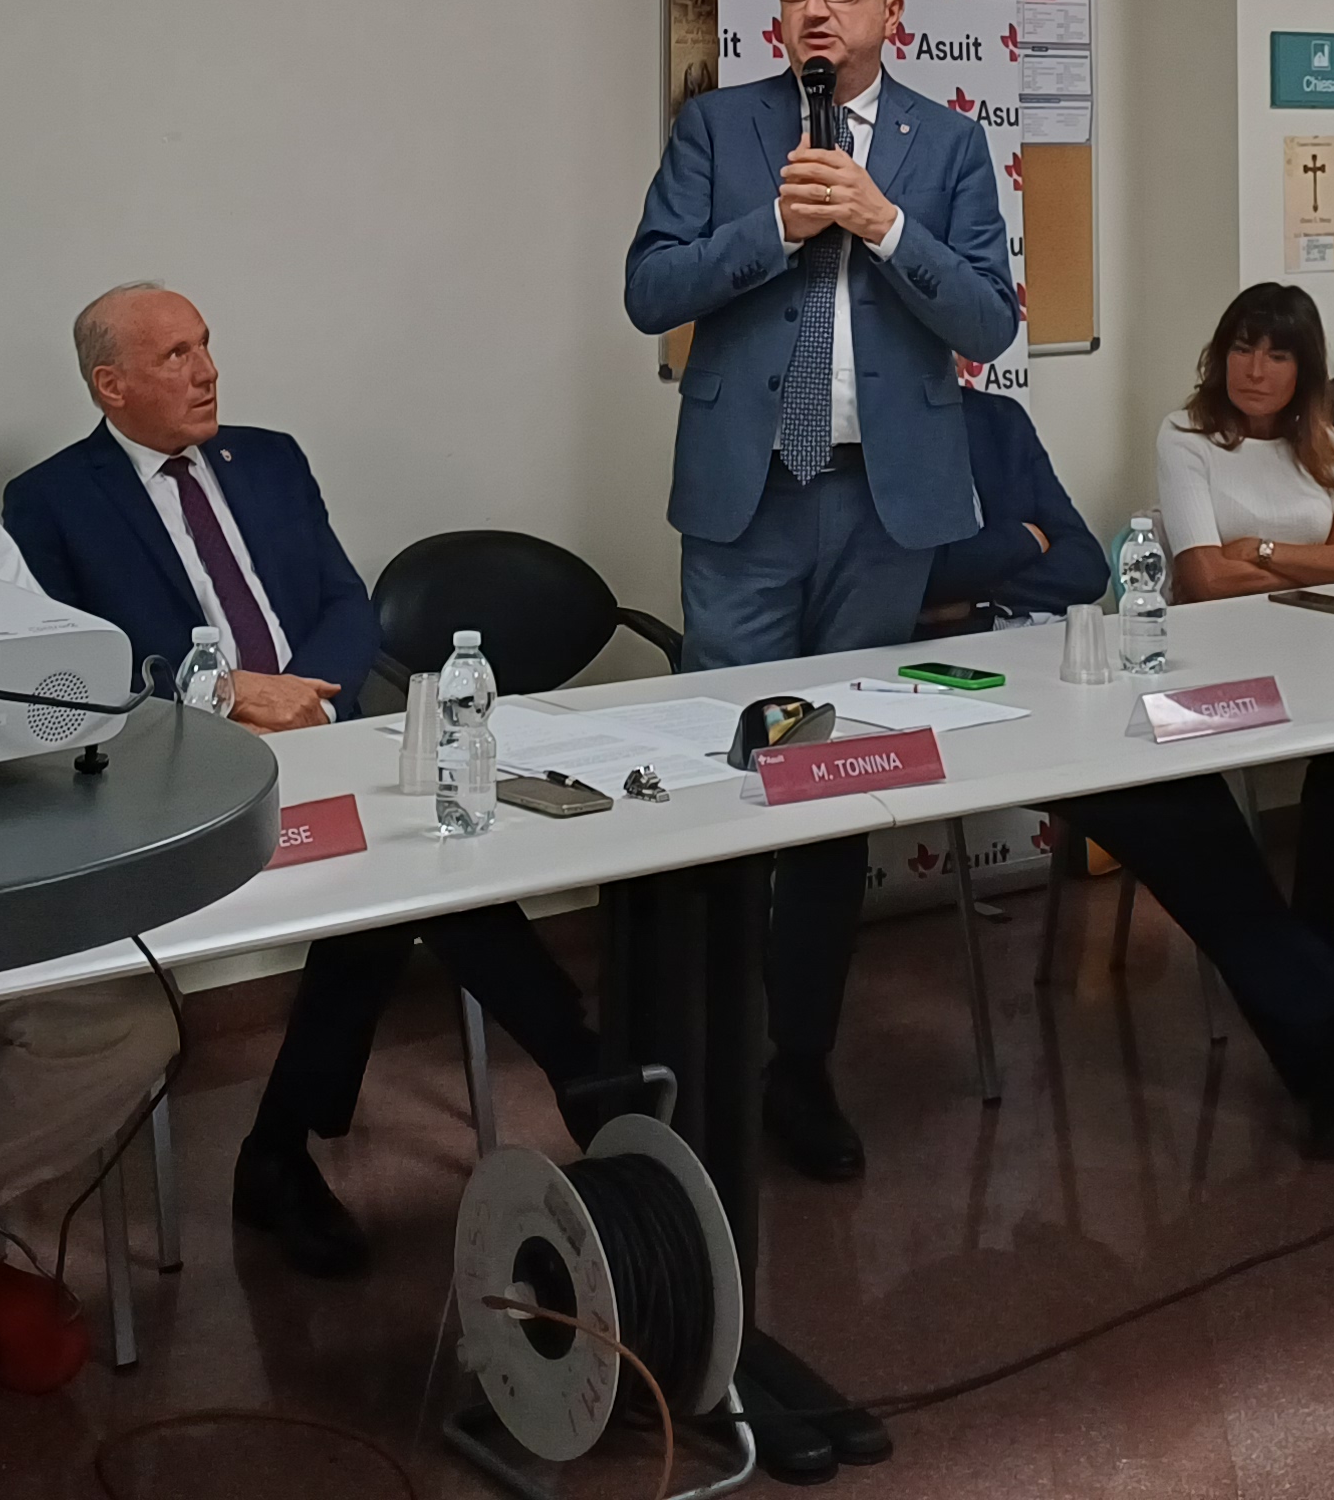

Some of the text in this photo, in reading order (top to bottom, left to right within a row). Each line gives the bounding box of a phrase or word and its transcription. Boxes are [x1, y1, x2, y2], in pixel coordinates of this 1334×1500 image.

[915, 32, 983, 61] Asuit
[976, 99, 1019, 128] Asu
[984, 362, 1029, 391] Asu
[812, 752, 904, 782] M. TONINA
